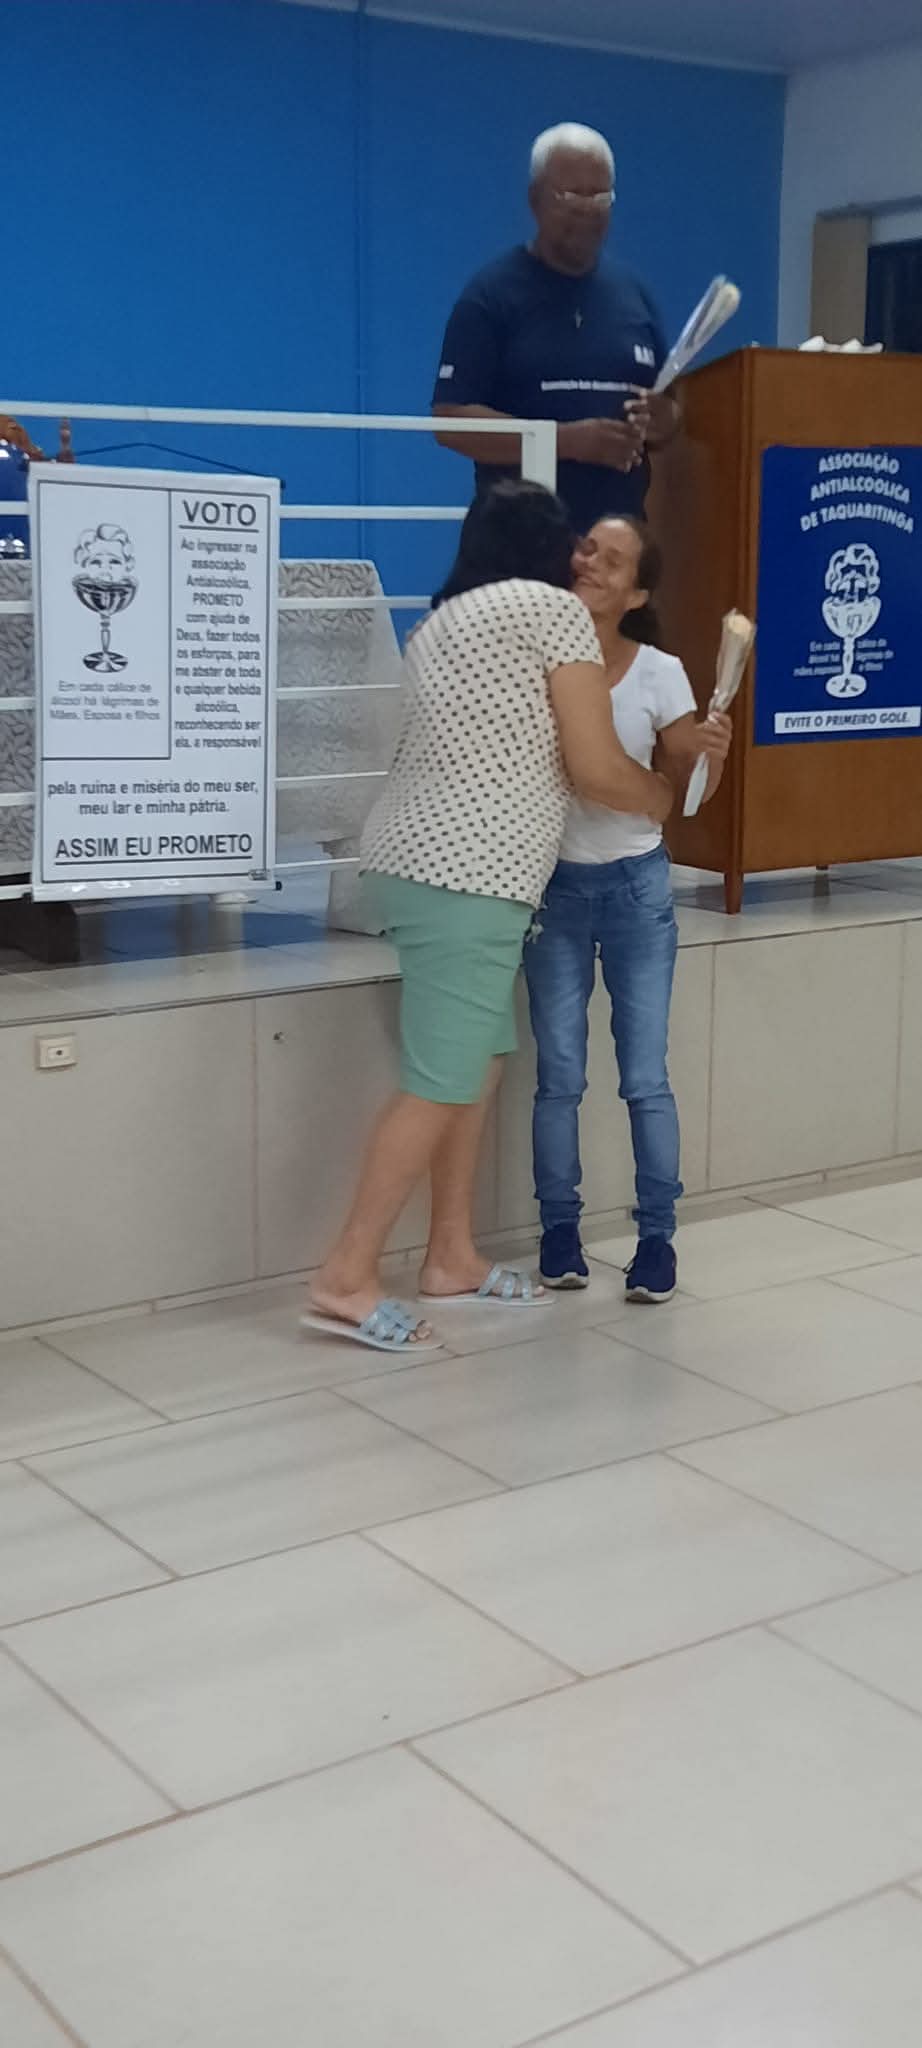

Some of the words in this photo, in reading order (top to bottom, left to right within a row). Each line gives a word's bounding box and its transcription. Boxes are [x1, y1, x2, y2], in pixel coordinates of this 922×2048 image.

[819, 452, 900, 474] ASSOCIAÇÃO
[183, 500, 257, 526] VOTO
[801, 511, 819, 532] DE
[820, 502, 914, 534] TAQUARITINGA
[181, 537, 195, 551] Ao
[197, 538, 242, 554] ingressar
[245, 543, 258, 553] na
[192, 558, 246, 572] associação
[193, 592, 243, 607] PROMETO
[186, 613, 207, 623] com
[209, 613, 235, 627] ajuda
[238, 613, 250, 625] de
[176, 628, 204, 642] Deus,
[206, 629, 230, 642] fazer
[232, 631, 261, 643] todos
[177, 649, 189, 659] os
[238, 650, 261, 662] para
[175, 667, 190, 677] me
[192, 666, 223, 678] abster
[225, 667, 236, 678] de
[238, 666, 261, 678] toda
[59, 680, 76, 692] Em
[79, 682, 105, 693] cada
[107, 682, 137, 693] cálice
[139, 683, 152, 693] de
[175, 685, 181, 695] e
[183, 683, 226, 697] qualquer
[228, 683, 261, 696] bebida
[84, 696, 97, 706] há
[147, 697, 160, 706] de
[126, 712, 133, 720] e
[135, 709, 160, 720] filhos
[784, 713, 812, 729] EVITE
[813, 714, 824, 728] O
[825, 712, 877, 728] PRIMEIRO
[879, 710, 911, 725] GOLE.
[175, 719, 242, 731] reconhecendo
[245, 721, 261, 731] ser
[48, 781, 76, 797] pela
[120, 783, 129, 794] e
[132, 778, 180, 794] miséria
[184, 779, 200, 793] do
[203, 781, 232, 793] meu
[234, 779, 259, 794] ser,
[79, 803, 109, 815] meu
[112, 800, 131, 814] lar
[134, 803, 143, 814] e
[146, 800, 185, 814] minha
[189, 798, 230, 816] pátria.
[55, 838, 119, 858] ASSIM
[125, 836, 151, 856] EU
[158, 834, 253, 855] PROMETO
